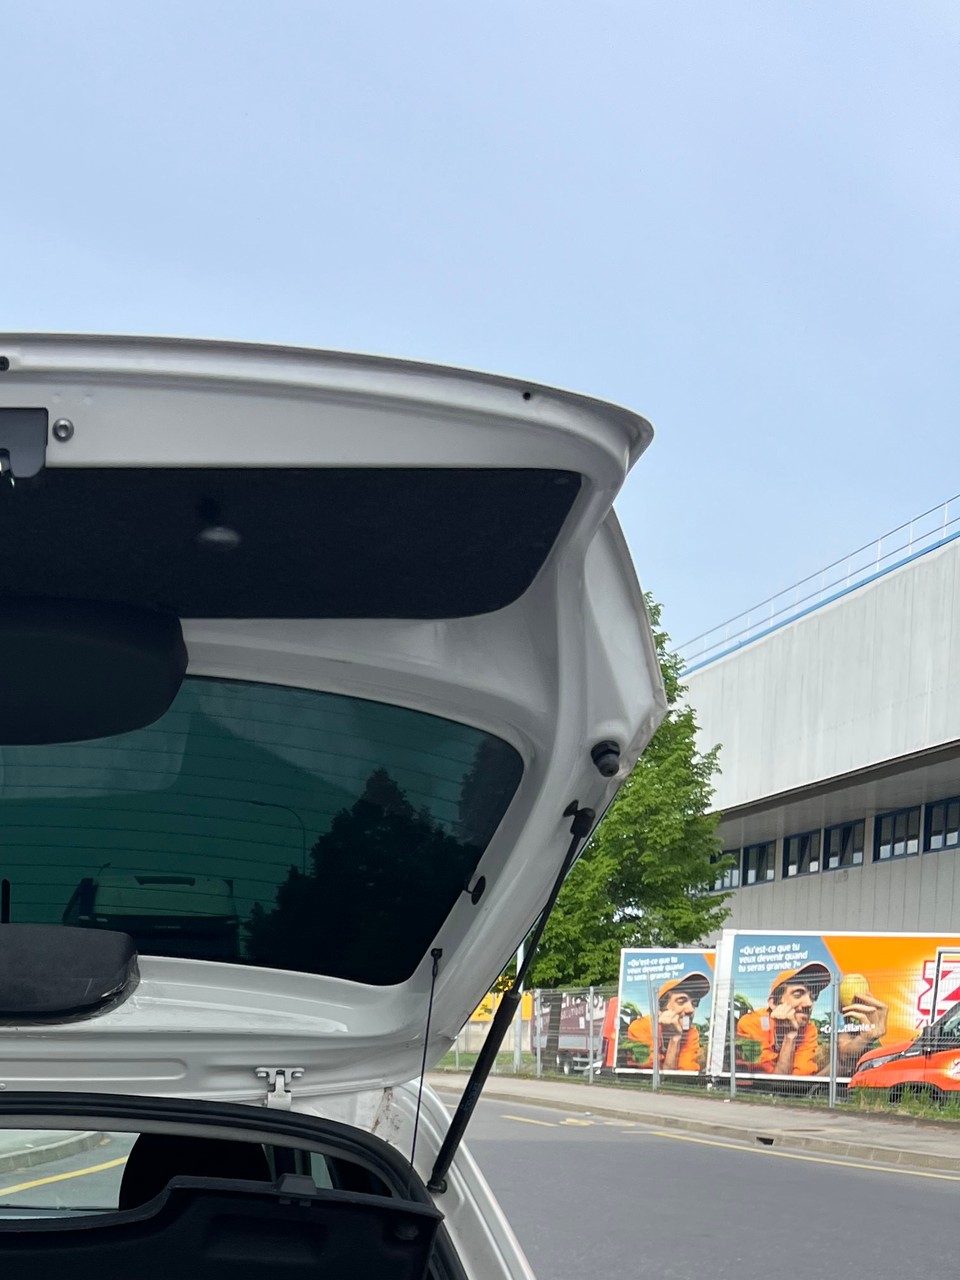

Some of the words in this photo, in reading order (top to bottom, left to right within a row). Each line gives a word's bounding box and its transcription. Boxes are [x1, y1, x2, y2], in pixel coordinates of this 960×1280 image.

[777, 944, 790, 953] que
[792, 943, 800, 951] tu
[739, 956, 756, 964] veux
[757, 953, 784, 962] devenir
[784, 950, 808, 961] quand
[738, 965, 746, 973] tu
[747, 964, 765, 972] seras
[766, 961, 792, 972] grande
